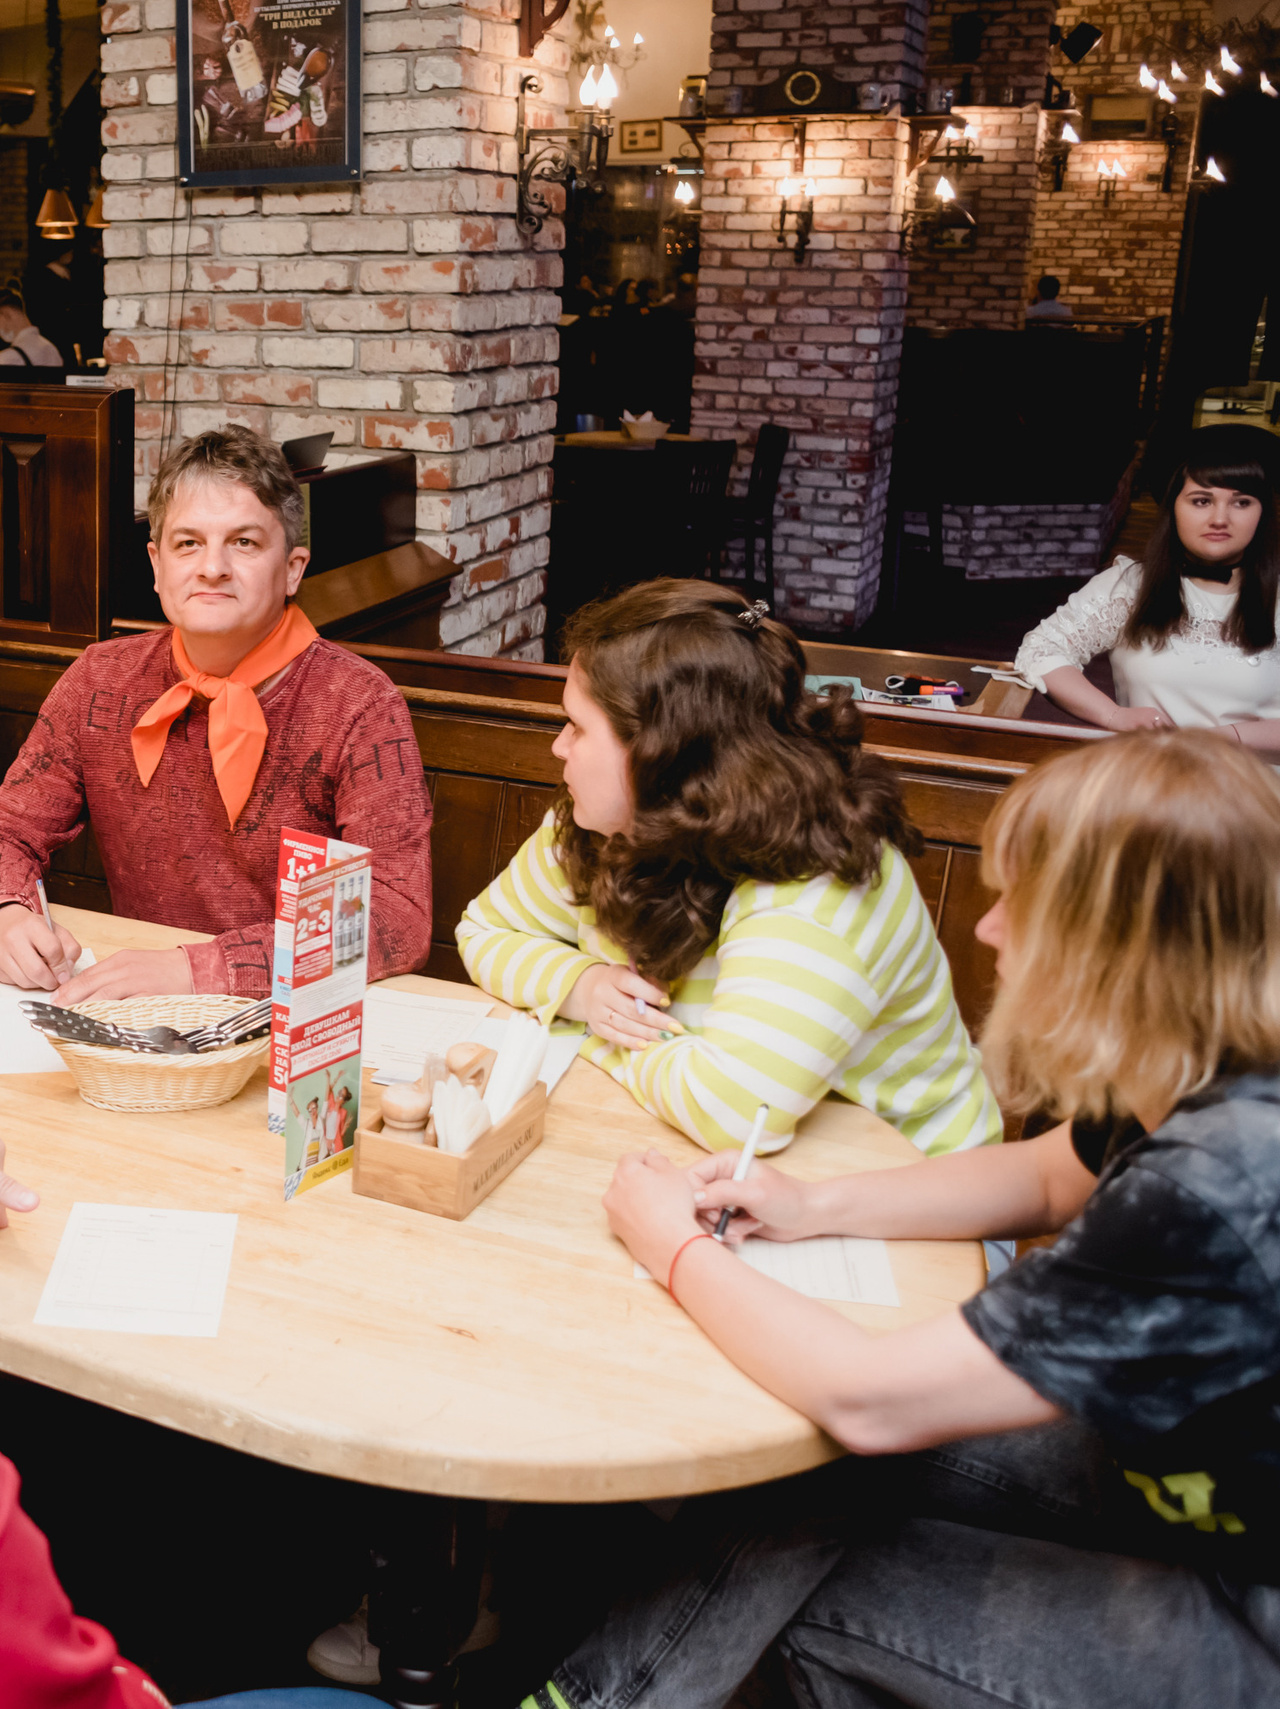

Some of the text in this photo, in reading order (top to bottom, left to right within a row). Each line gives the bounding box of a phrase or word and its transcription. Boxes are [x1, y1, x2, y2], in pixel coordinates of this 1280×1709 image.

[272, 17, 322, 30] В ПОДАРОК
[282, 10, 307, 20] ВИДА
[295, 909, 331, 942] 2=3
[290, 1037, 312, 1054] ВХОД
[312, 1014, 361, 1044] СВОБОДНЫЙ
[303, 1009, 350, 1038] ДЕВУШКАМ
